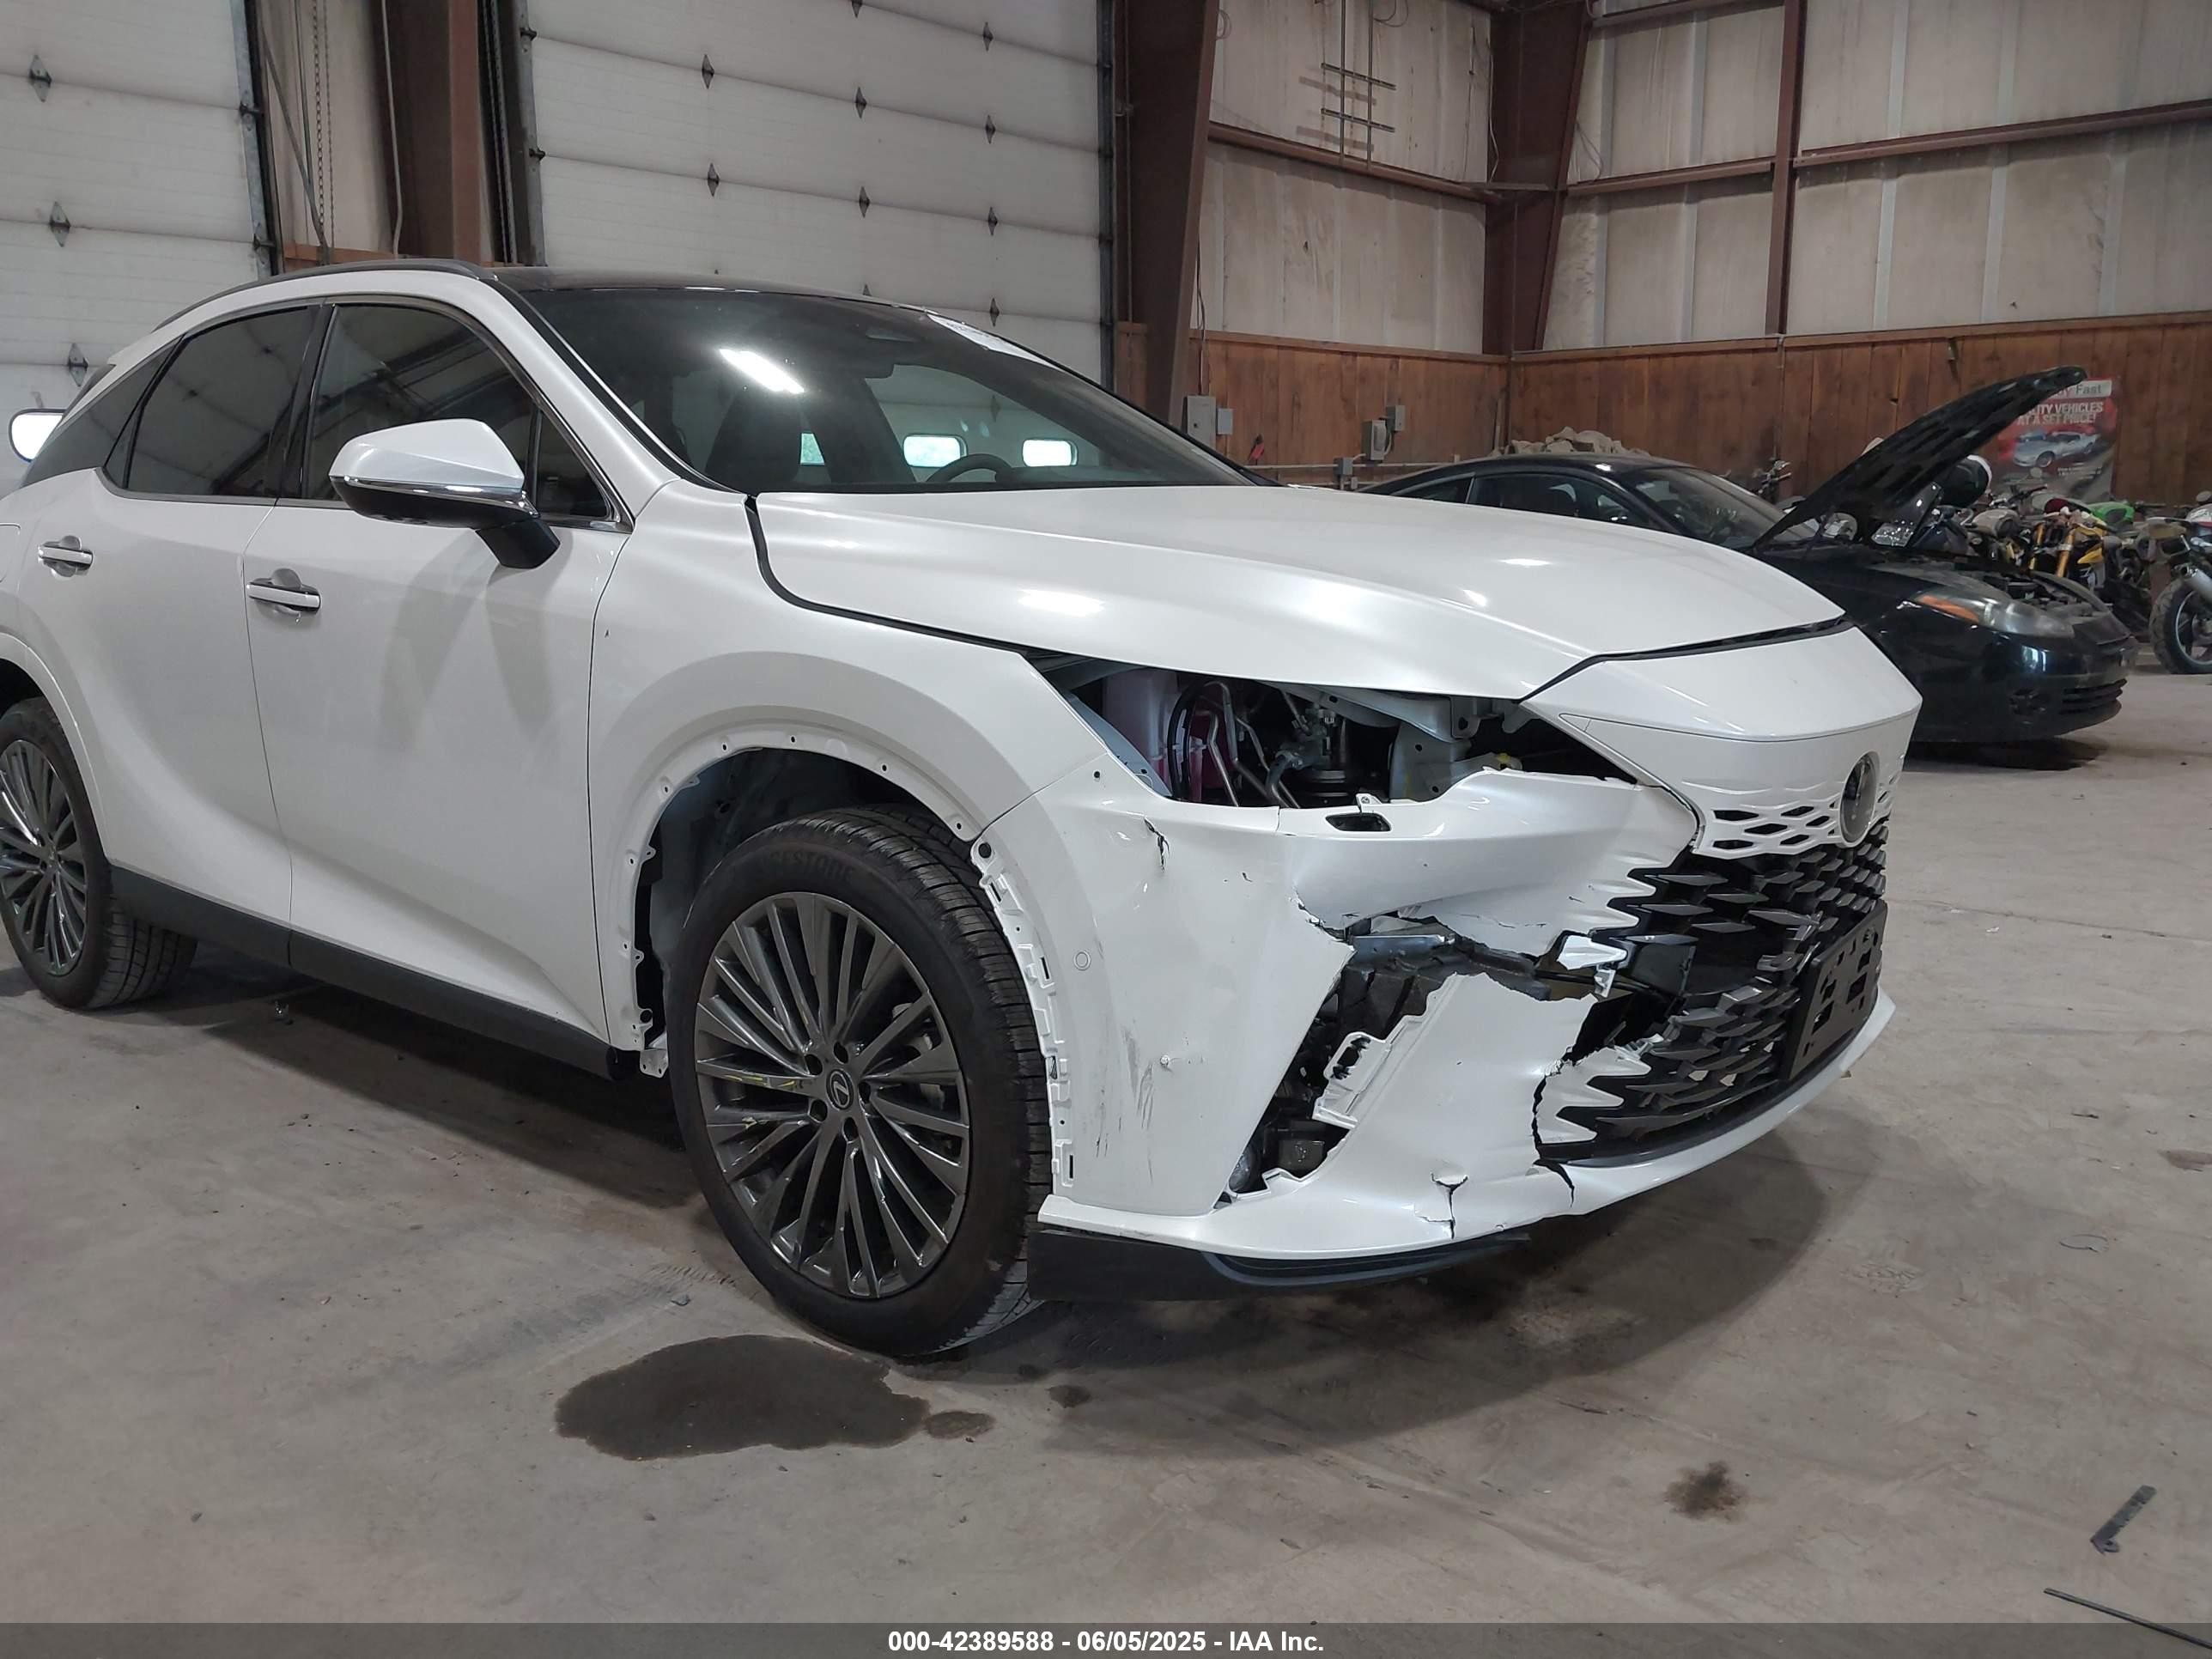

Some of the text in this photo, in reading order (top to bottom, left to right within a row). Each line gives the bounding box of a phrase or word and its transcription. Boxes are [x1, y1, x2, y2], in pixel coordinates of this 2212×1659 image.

[2075, 384, 2102, 394] Fast
[2055, 402, 2104, 413] VEHICLES
[2031, 414, 2040, 425] A
[2042, 414, 2063, 425] SET
